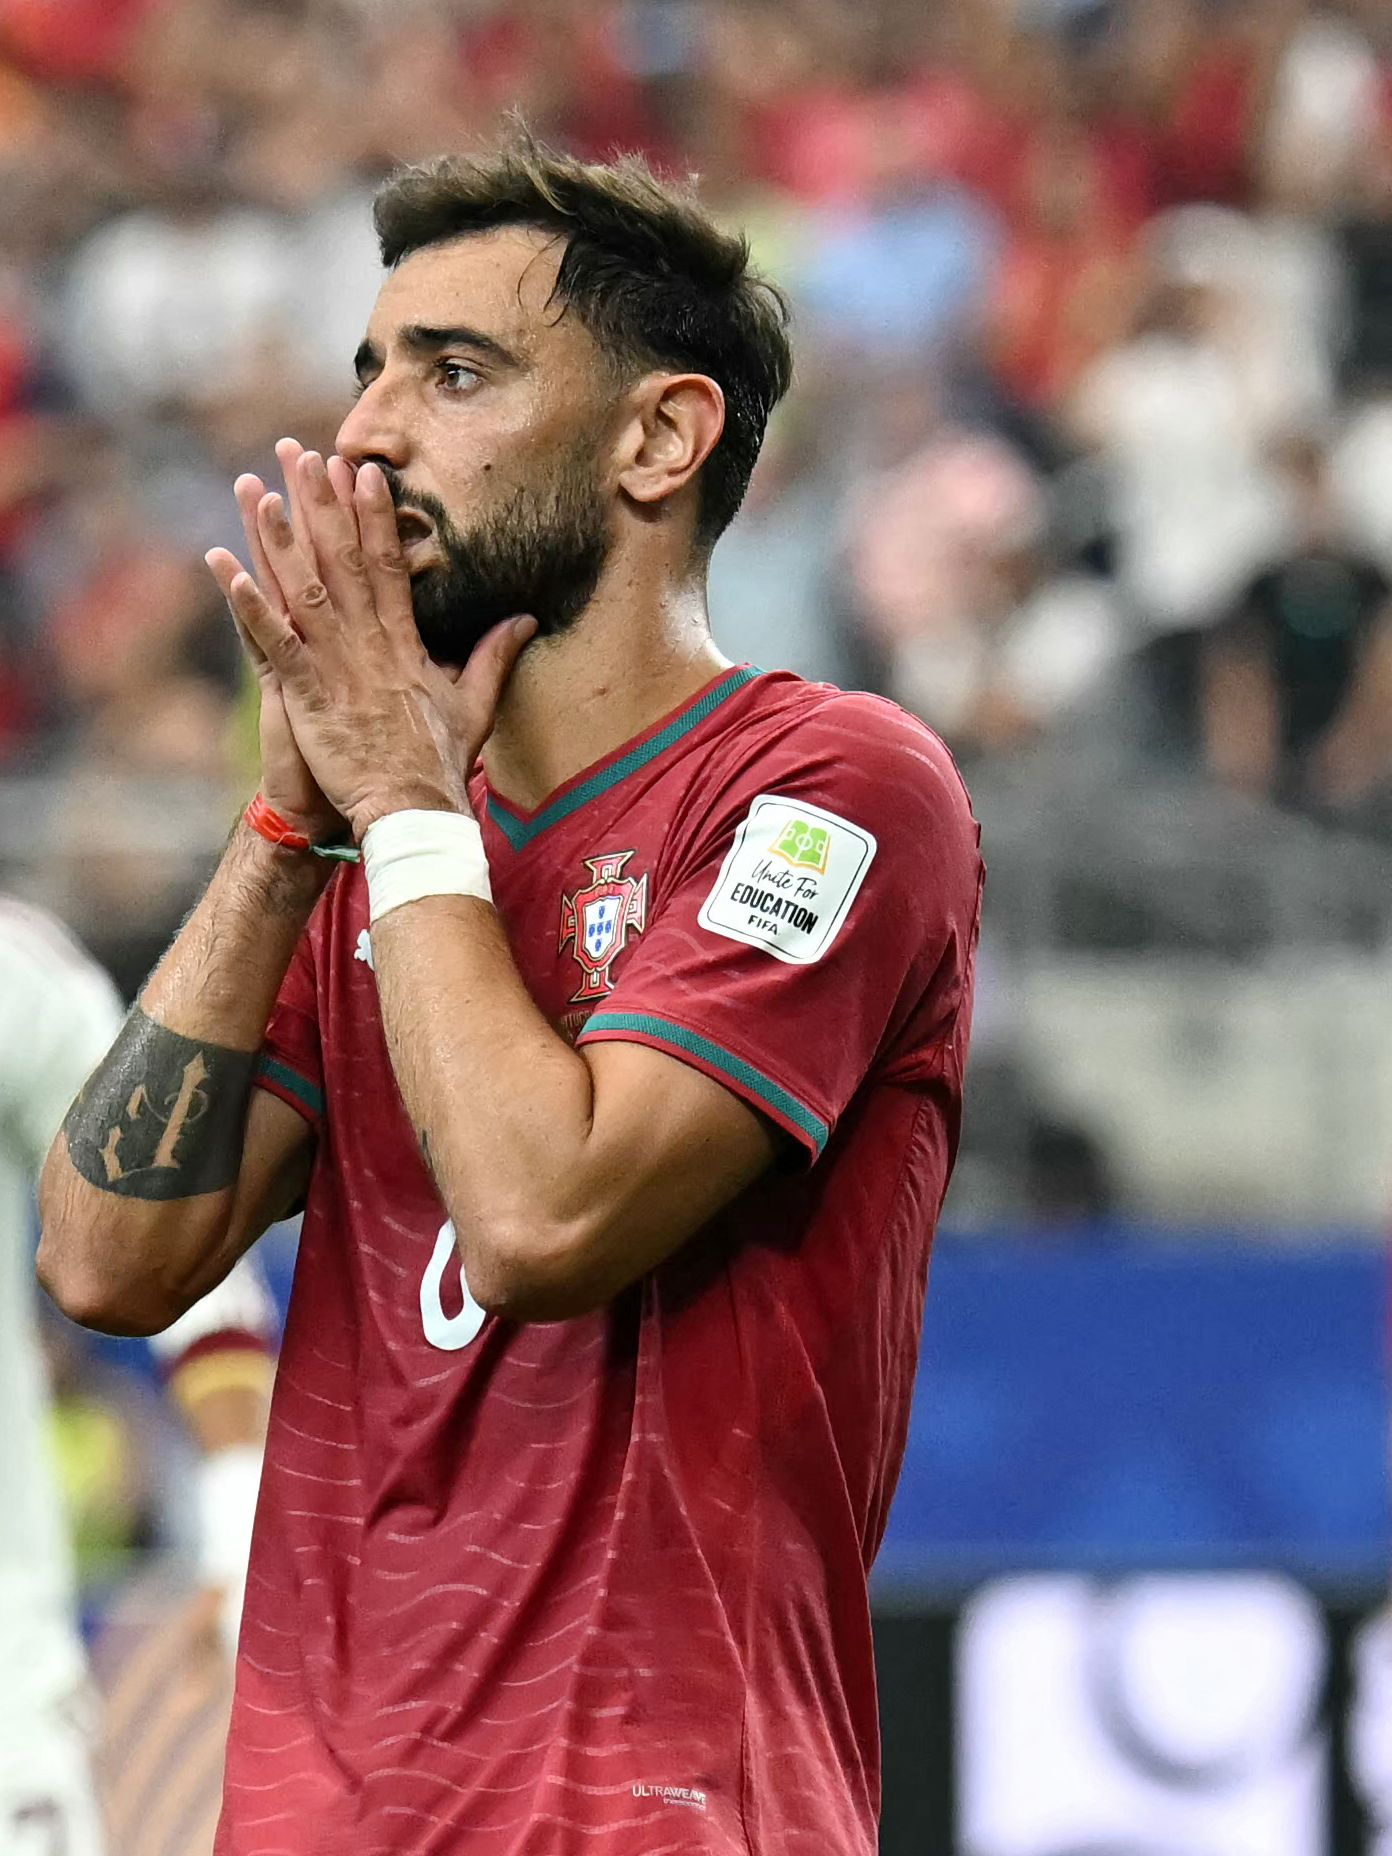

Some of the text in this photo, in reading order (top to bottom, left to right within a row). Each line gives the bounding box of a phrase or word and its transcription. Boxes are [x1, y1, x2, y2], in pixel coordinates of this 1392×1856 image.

[751, 859, 819, 901] Unite For
[730, 882, 819, 935] EDUCATION
[747, 914, 778, 936] FIFA
